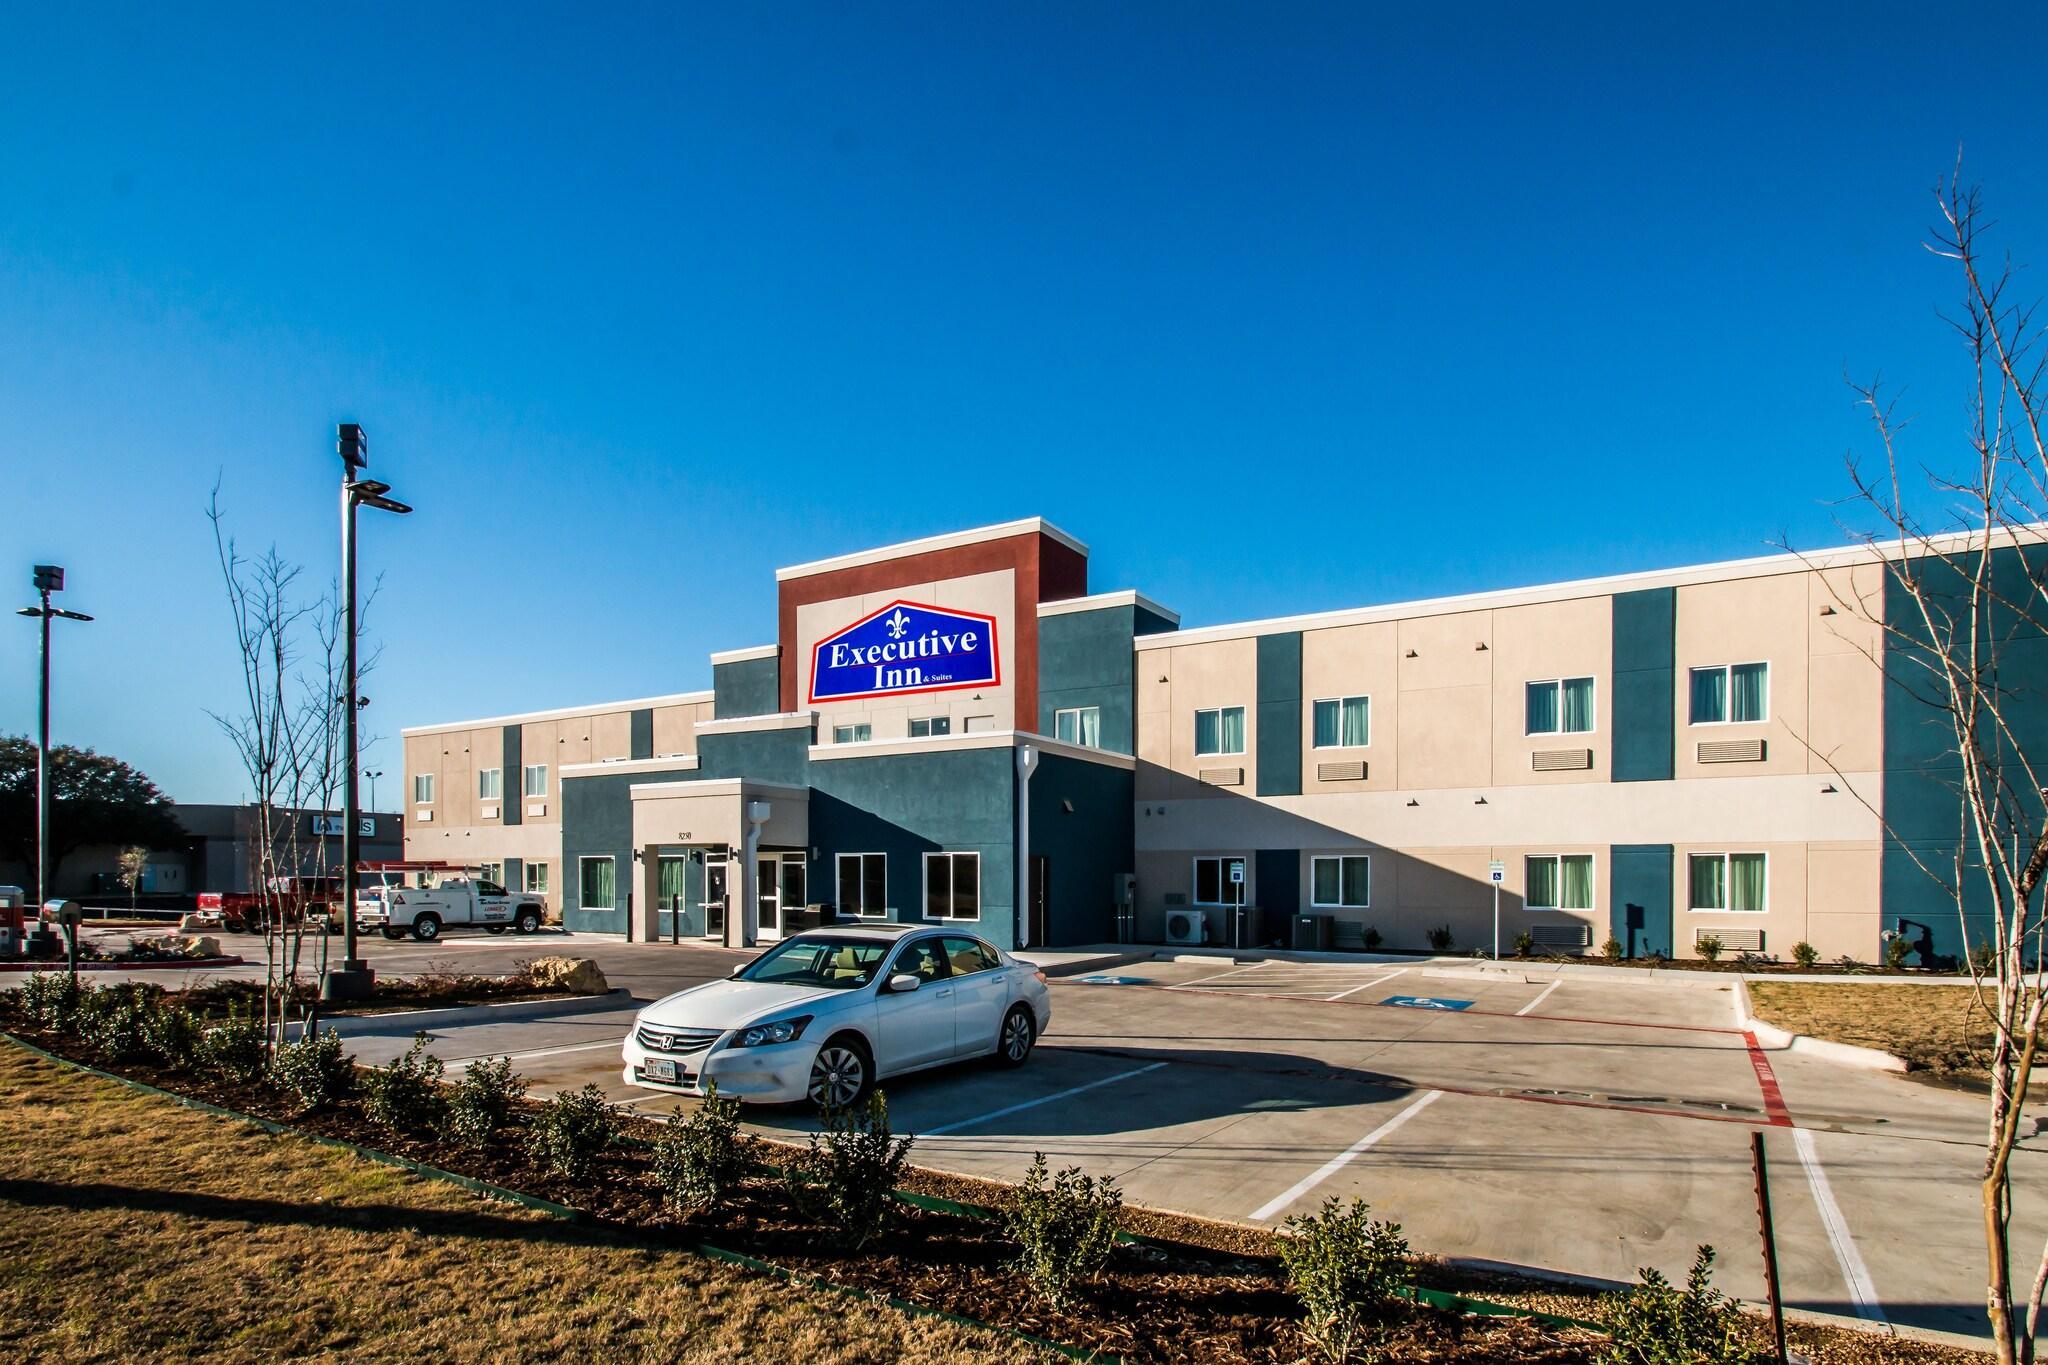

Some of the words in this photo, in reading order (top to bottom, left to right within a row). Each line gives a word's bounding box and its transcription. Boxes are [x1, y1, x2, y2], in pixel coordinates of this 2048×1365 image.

[829, 630, 977, 668] Executive
[873, 665, 922, 689] Inn
[931, 674, 952, 682] Suites
